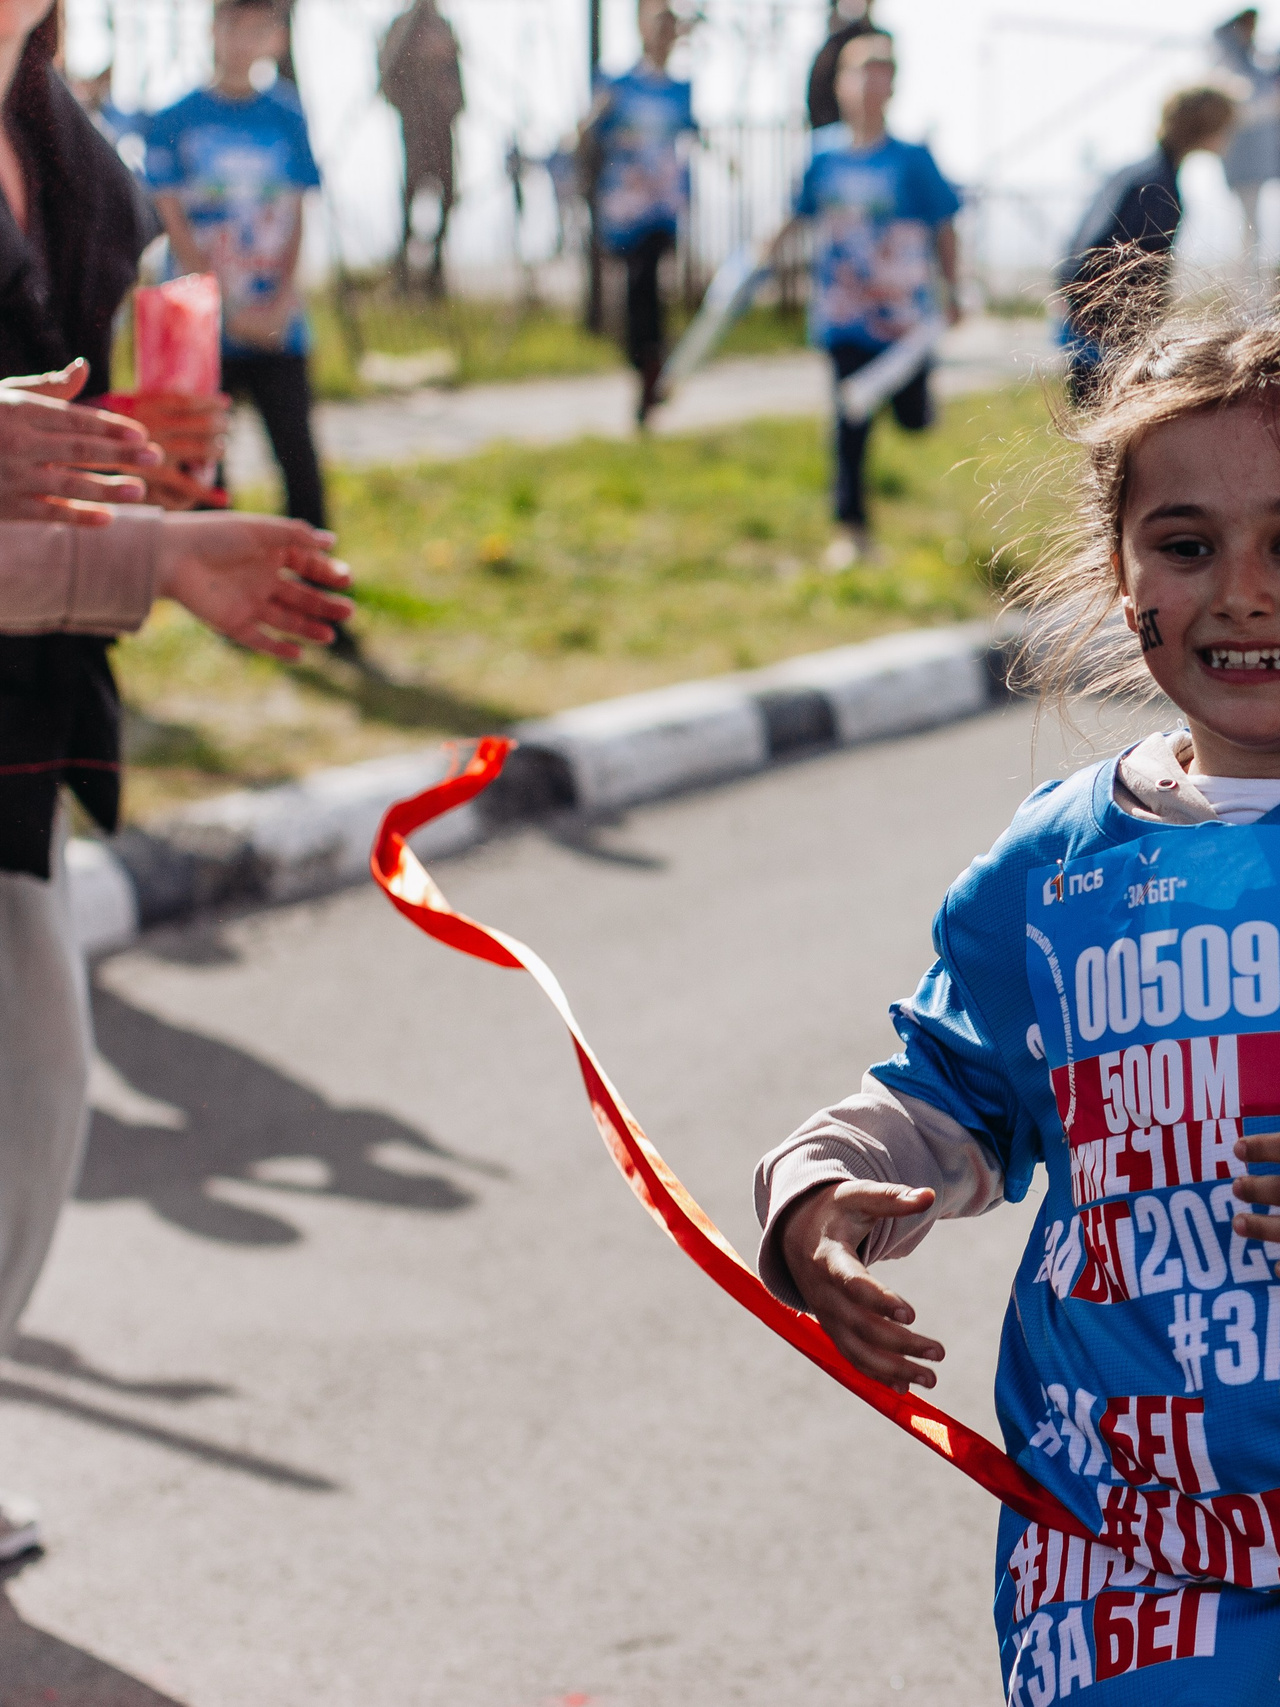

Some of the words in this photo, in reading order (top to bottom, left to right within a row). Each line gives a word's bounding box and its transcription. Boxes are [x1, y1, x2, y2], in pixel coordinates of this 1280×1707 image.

[1068, 868, 1104, 896] ПСБ
[1100, 1039, 1184, 1134] 500
[1190, 1035, 1241, 1121] М
